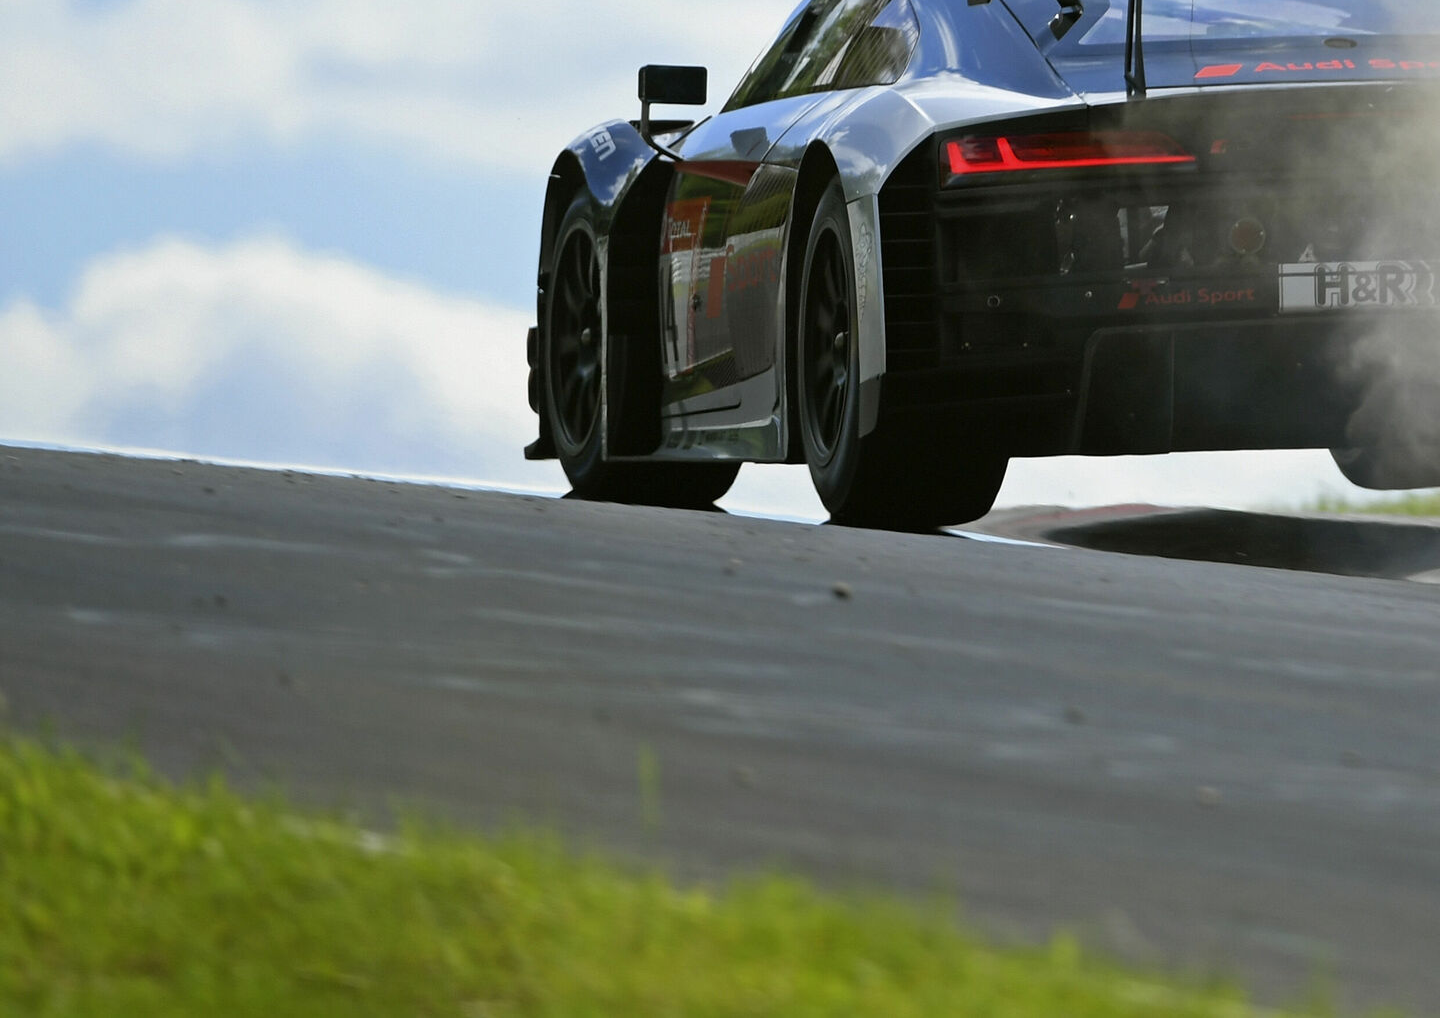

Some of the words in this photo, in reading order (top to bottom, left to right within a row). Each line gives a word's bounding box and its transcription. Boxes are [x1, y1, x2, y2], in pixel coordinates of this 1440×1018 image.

[1255, 59, 1356, 72] Audi
[1315, 263, 1412, 306] H&R
[1145, 289, 1191, 305] Audi
[1198, 287, 1255, 305] Sport
